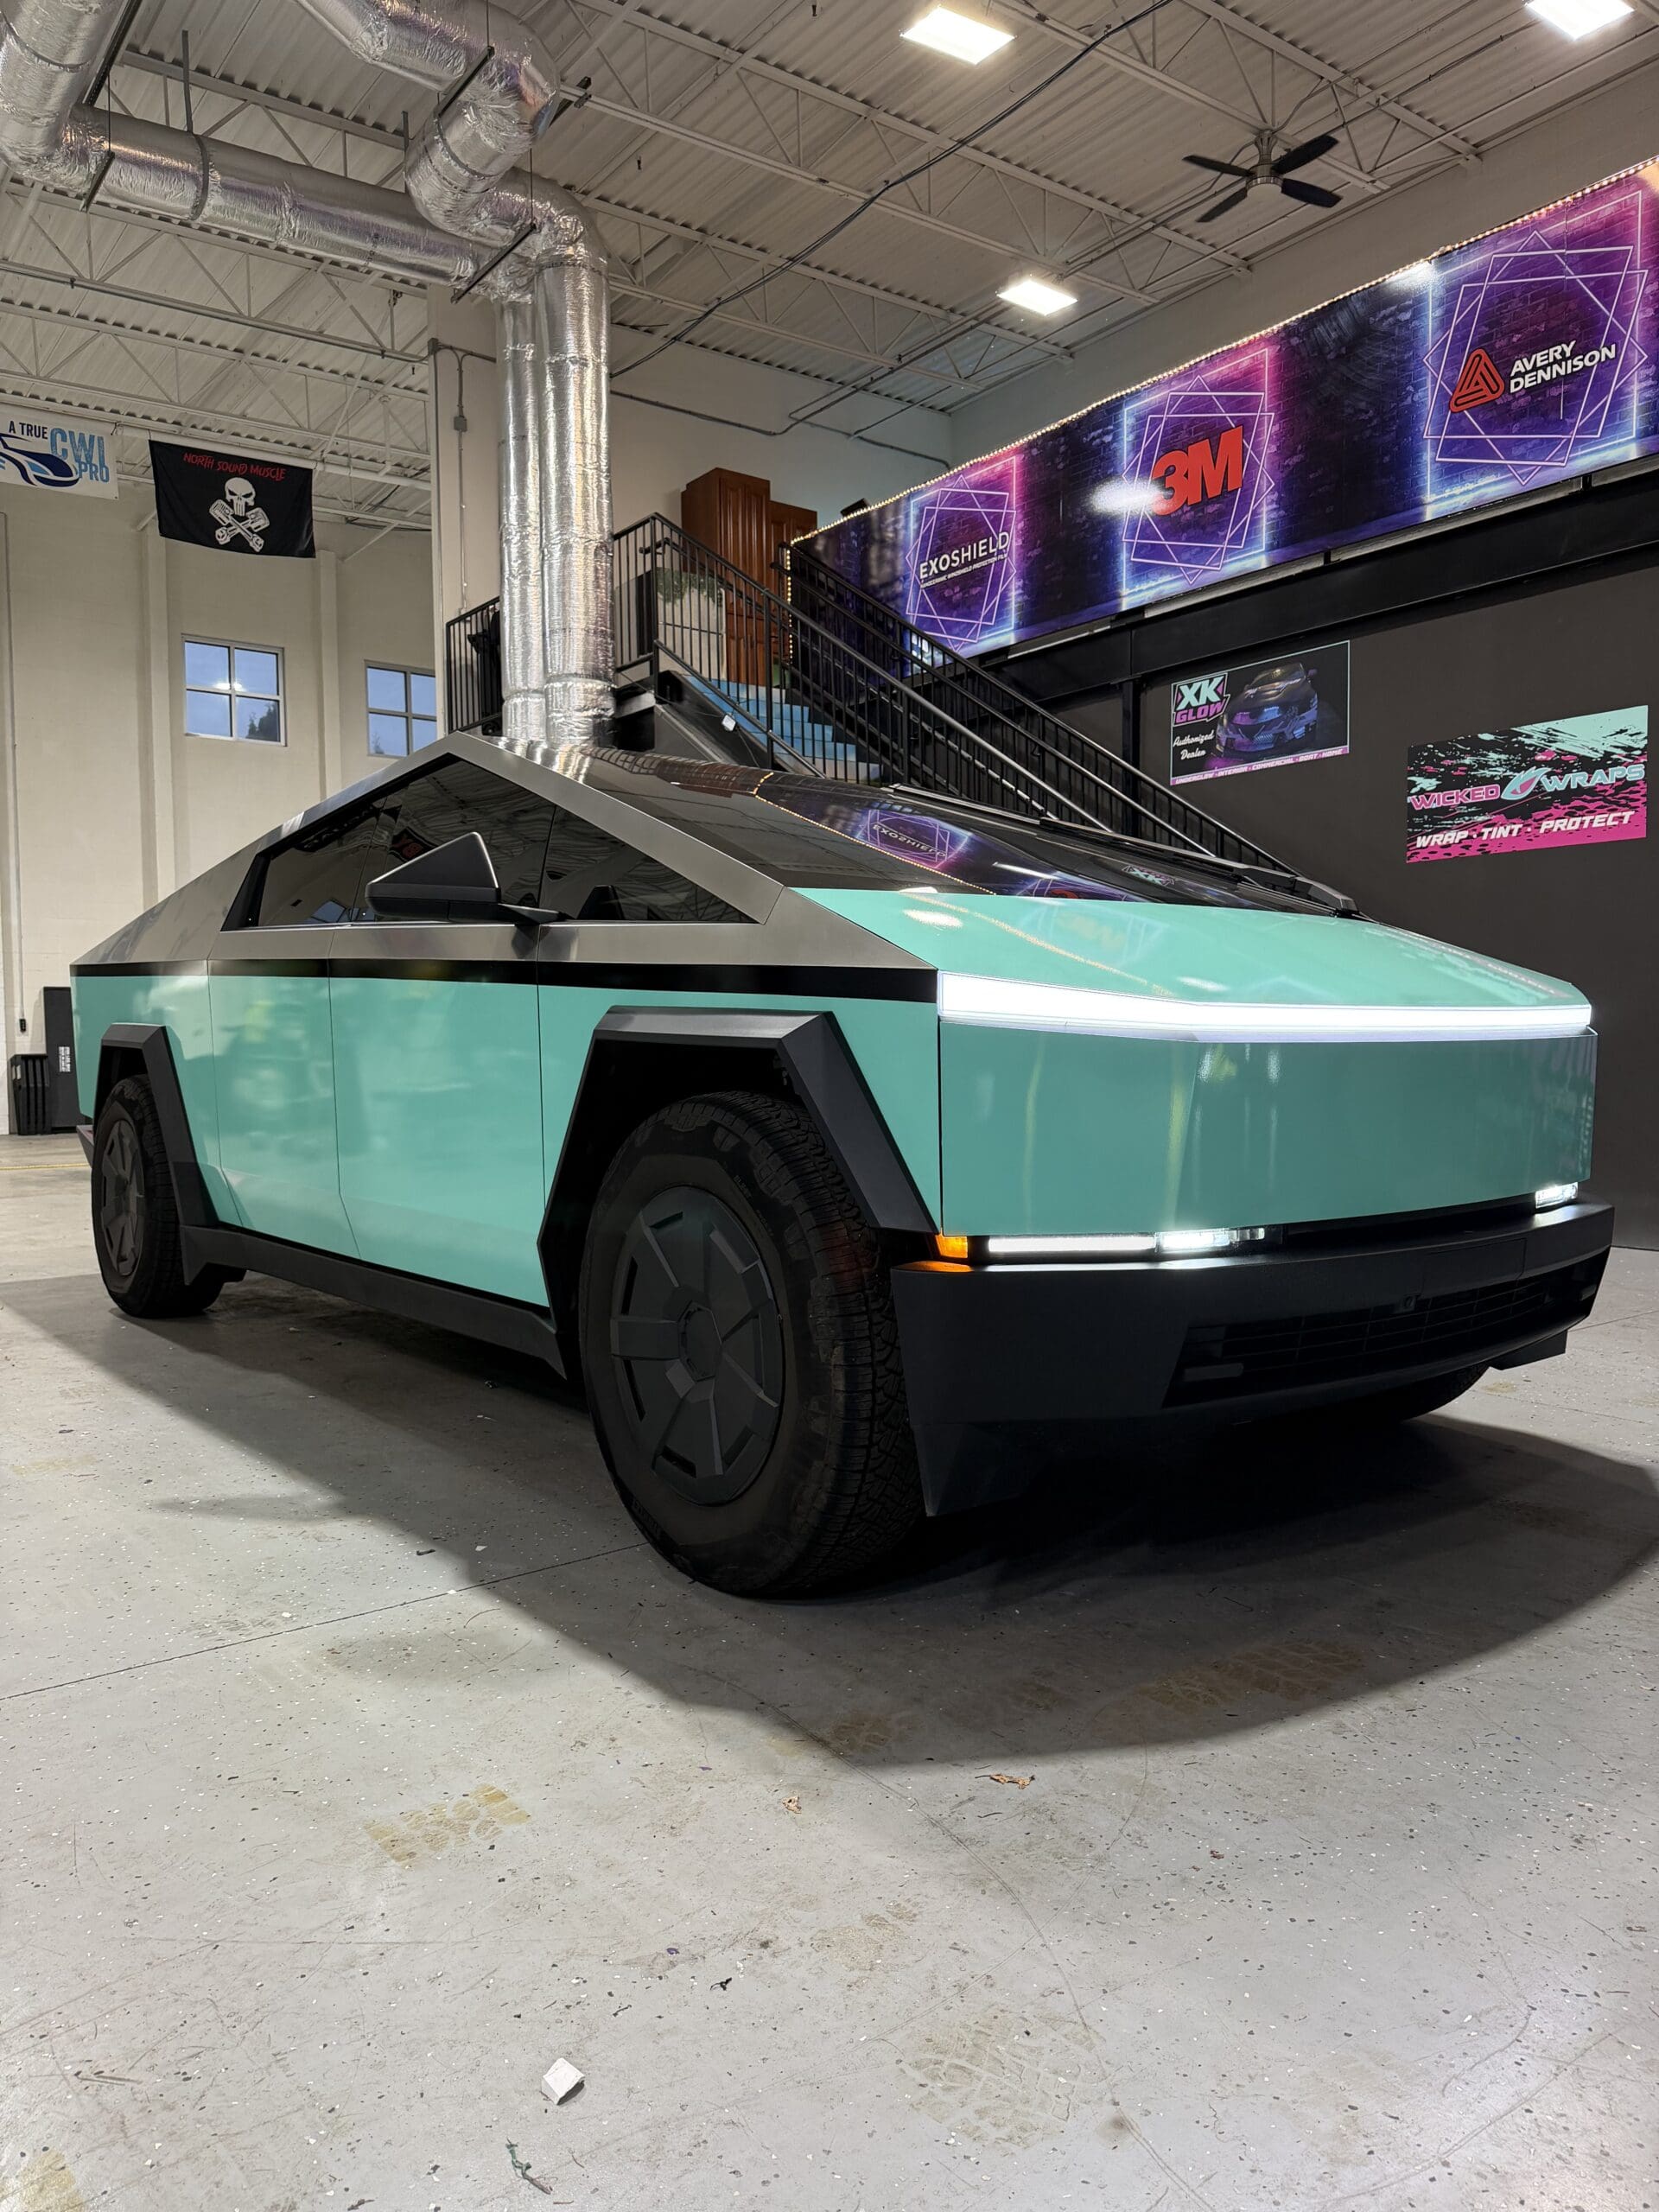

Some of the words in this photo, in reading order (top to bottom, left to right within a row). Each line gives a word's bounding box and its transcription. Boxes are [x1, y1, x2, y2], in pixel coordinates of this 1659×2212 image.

[1510, 340, 1576, 377] AVERY
[1510, 343, 1616, 393] DENNISON
[9, 420, 16, 434] A
[19, 422, 48, 440] TRUE
[50, 427, 105, 466] CWI
[78, 461, 110, 482] PRO
[183, 453, 215, 469] NORTH
[217, 461, 248, 475] SOUND
[249, 464, 286, 481] MUSCLE
[1152, 425, 1243, 516] 3M
[919, 531, 1009, 579] EXOSHIELD
[1175, 698, 1226, 723] GLOW
[1176, 676, 1224, 710] XK
[1173, 729, 1215, 747] Authorized
[1180, 747, 1206, 760] Dealer
[1409, 784, 1501, 810] WICKED
[1541, 764, 1646, 791] WRAPS
[1415, 830, 1469, 848] WRAP
[1481, 823, 1524, 841] TINT
[1540, 810, 1636, 834] PROTECT
